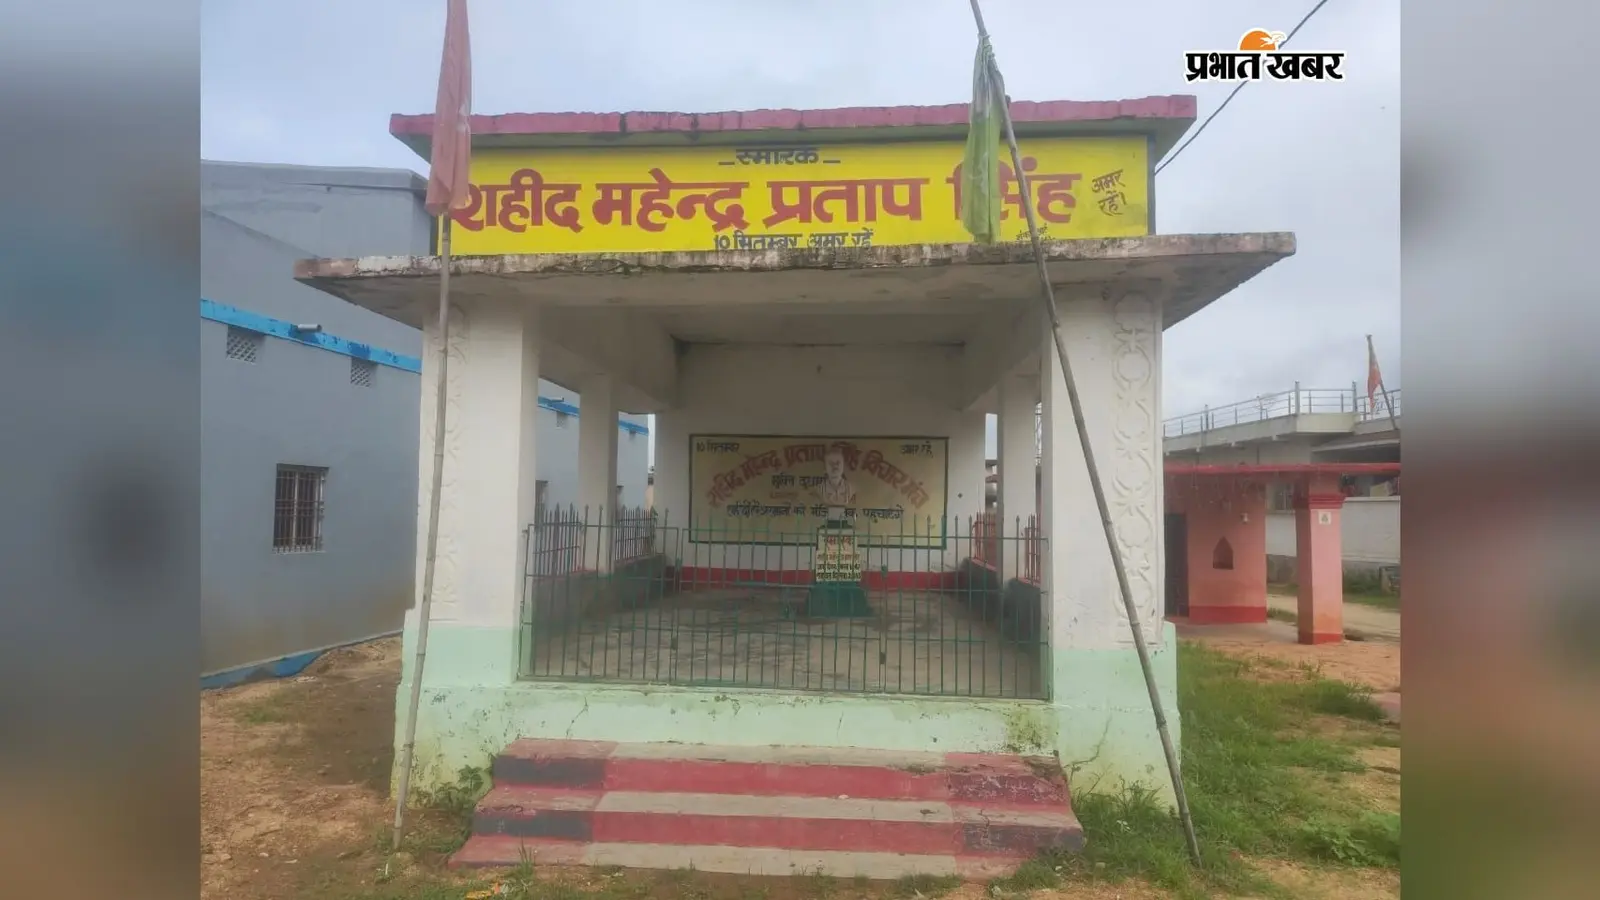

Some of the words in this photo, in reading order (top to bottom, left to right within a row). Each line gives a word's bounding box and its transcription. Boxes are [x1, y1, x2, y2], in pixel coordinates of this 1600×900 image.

[735, 148, 820, 165] स्मारक
[1091, 169, 1126, 194] अमर
[451, 168, 584, 233] शहीद
[592, 168, 750, 232] महेन्द्र
[762, 178, 930, 229] प्रताप
[807, 233, 849, 248] अमर
